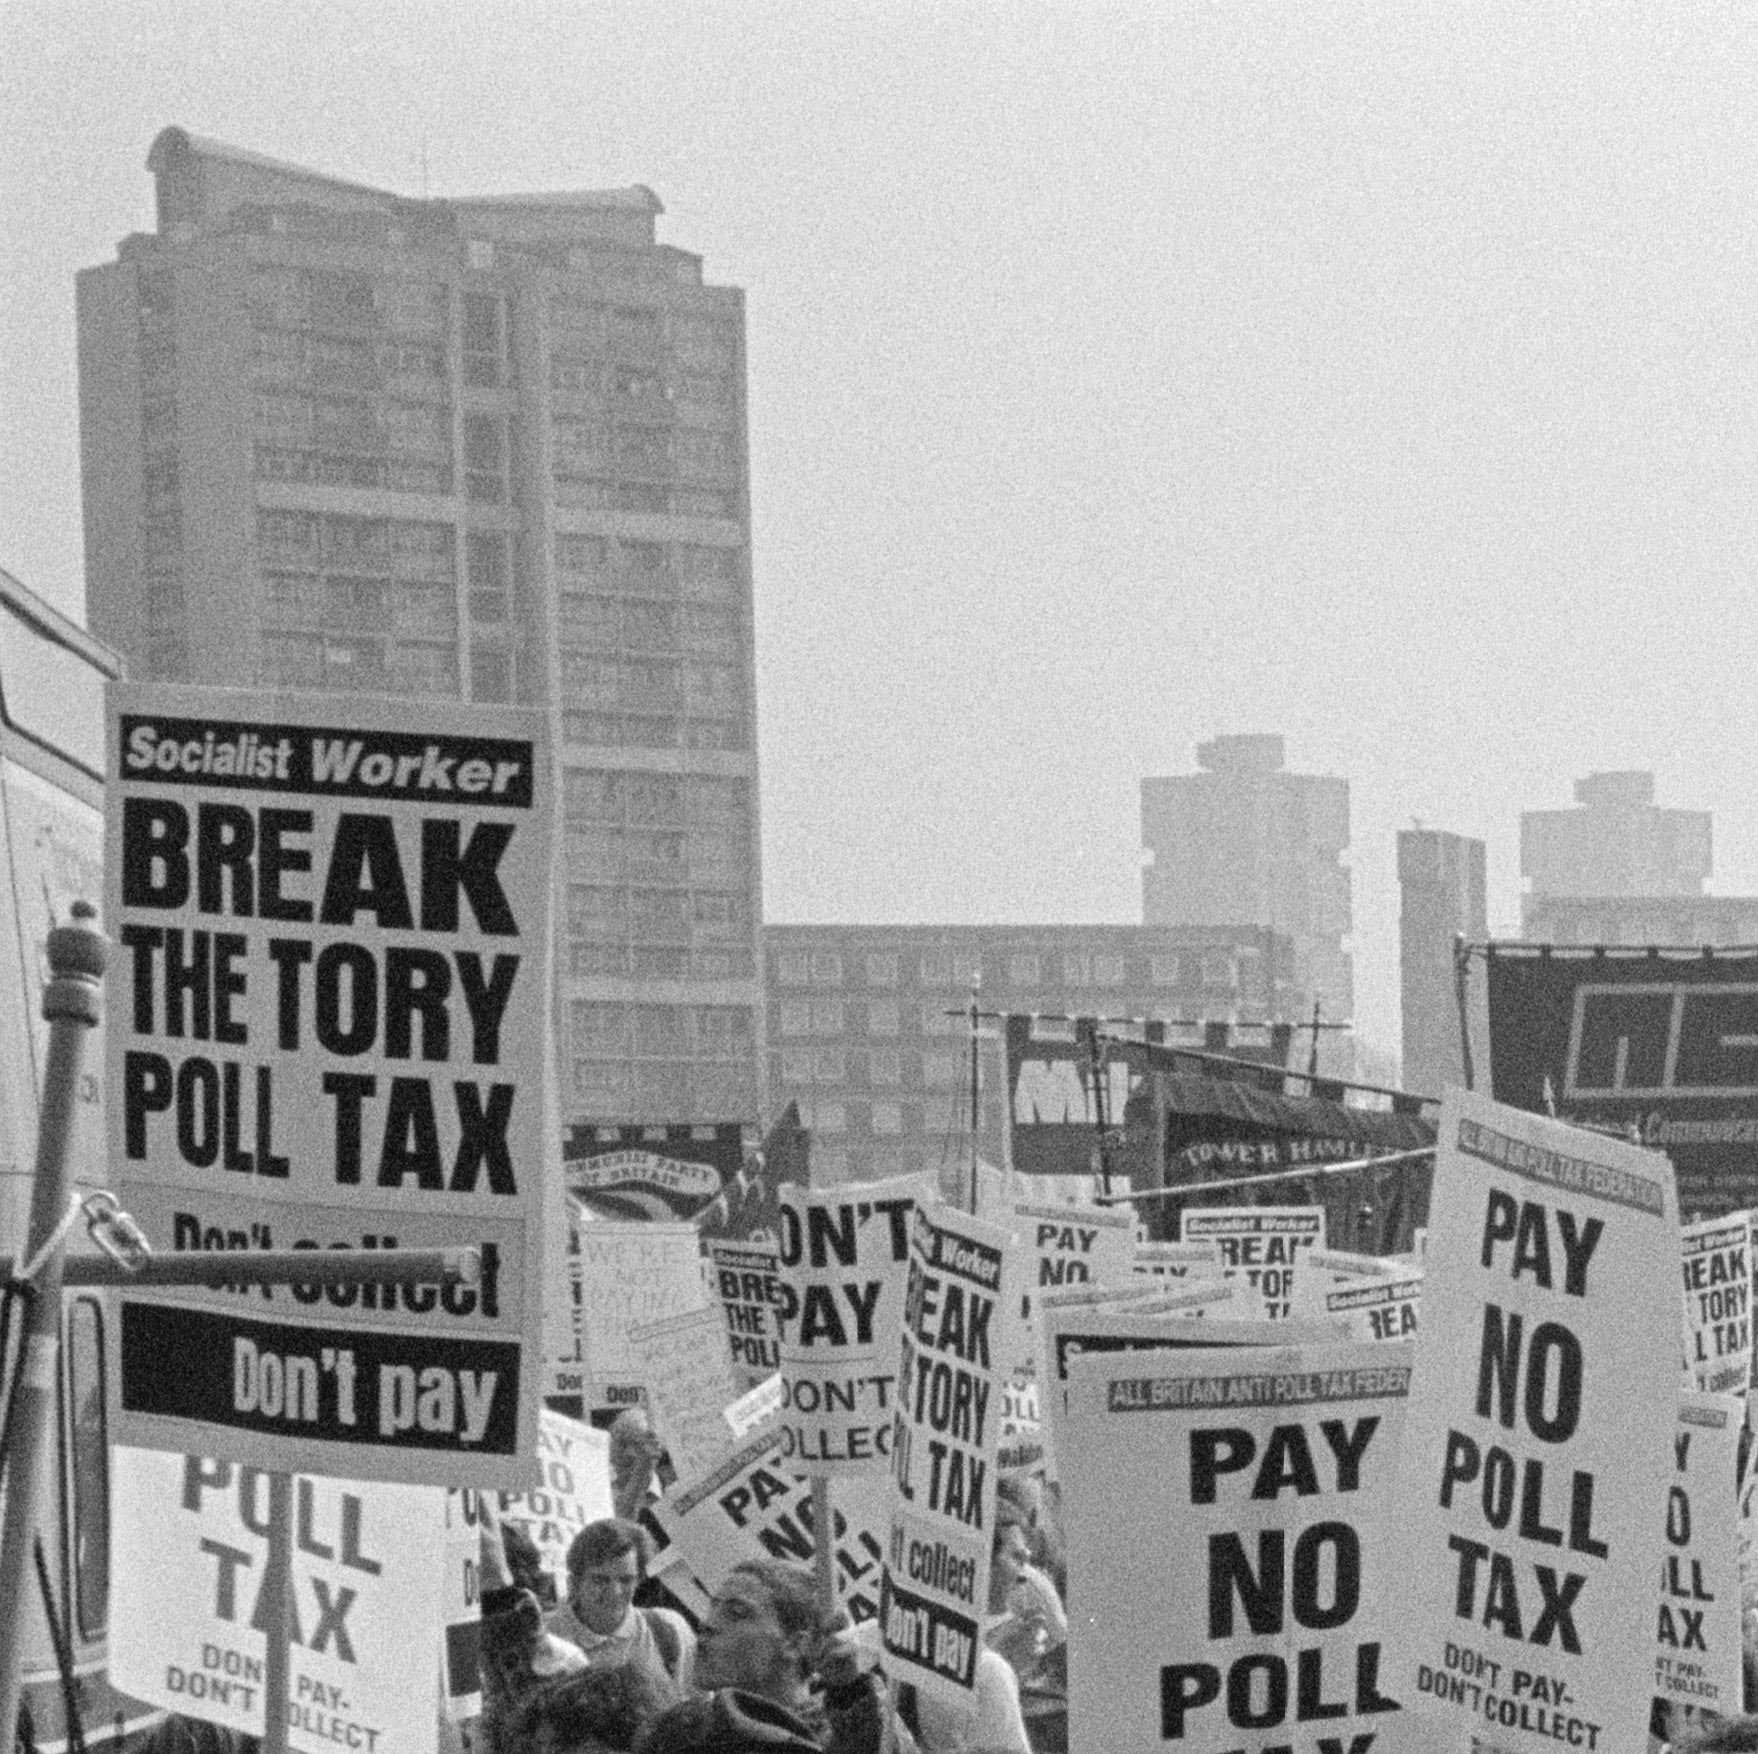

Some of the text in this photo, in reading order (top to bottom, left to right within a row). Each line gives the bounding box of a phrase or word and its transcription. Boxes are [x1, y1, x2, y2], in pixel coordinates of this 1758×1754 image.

[127, 726, 520, 794] Socialist Worker
[121, 797, 520, 936] BREAK
[121, 924, 521, 1064] THE TORY
[124, 1050, 518, 1195] POLL TAX
[1181, 1141, 1280, 1167] TOWER
[1036, 1223, 1098, 1253] PAY
[1259, 1217, 1320, 1234] Worker
[1481, 1187, 1605, 1298] PAY
[1698, 1283, 1748, 1325] TORY
[233, 1336, 501, 1441] Don't pay
[915, 1353, 991, 1448] TORY
[1474, 1302, 1583, 1444] NO
[929, 1439, 984, 1531] TAX
[1188, 1415, 1381, 1505] PAY
[1438, 1427, 1609, 1560] POLL
[909, 1539, 976, 1605] collect
[1207, 1520, 1361, 1639] NO
[1447, 1533, 1588, 1656] TAX
[1159, 1642, 1402, 1740] POLL
[1416, 1666, 1602, 1752] DON'T COLLECT
[1443, 1642, 1575, 1707] DON'T PAY-
